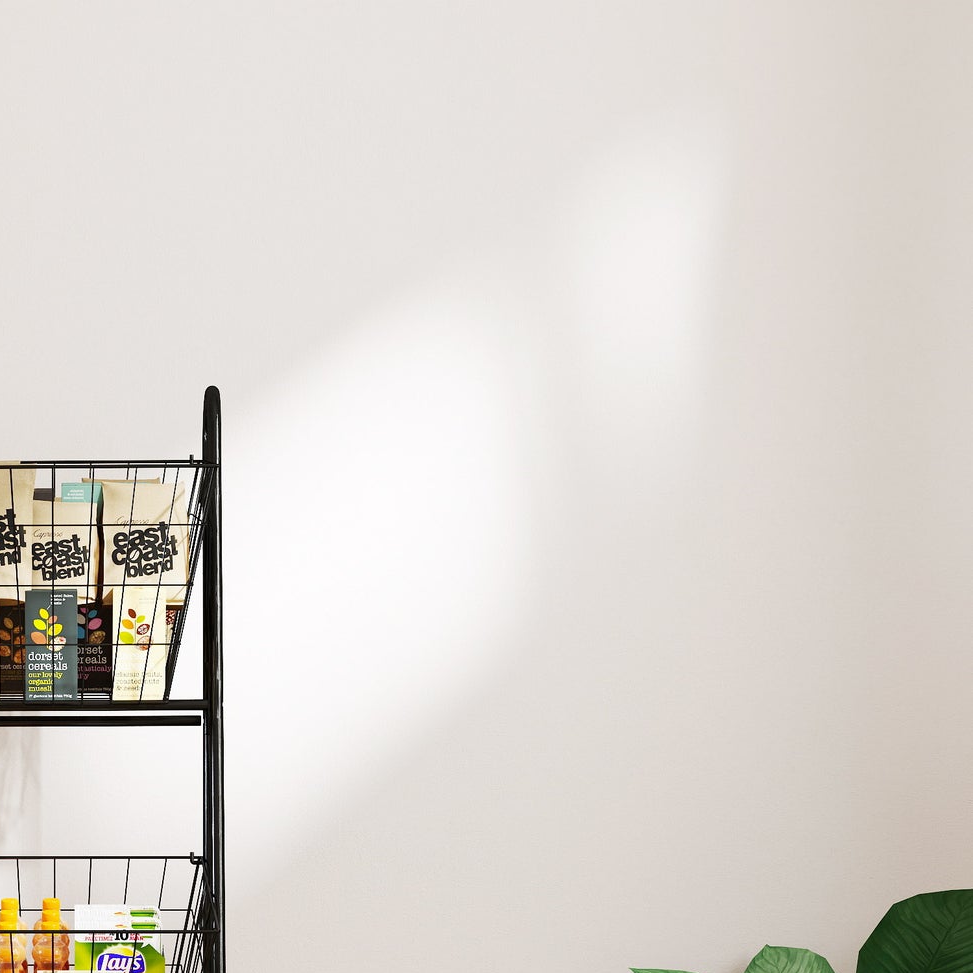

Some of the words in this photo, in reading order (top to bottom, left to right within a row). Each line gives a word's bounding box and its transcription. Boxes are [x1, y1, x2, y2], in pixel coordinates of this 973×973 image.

[31, 534, 80, 557] east
[113, 521, 169, 549] east
[32, 545, 89, 570] coast
[111, 535, 178, 565] coast
[42, 562, 85, 581] blend
[127, 555, 173, 578] blend
[28, 652, 64, 661] dorset
[77, 646, 103, 655] orset
[77, 655, 107, 664] ereals
[28, 662, 68, 671] cereals
